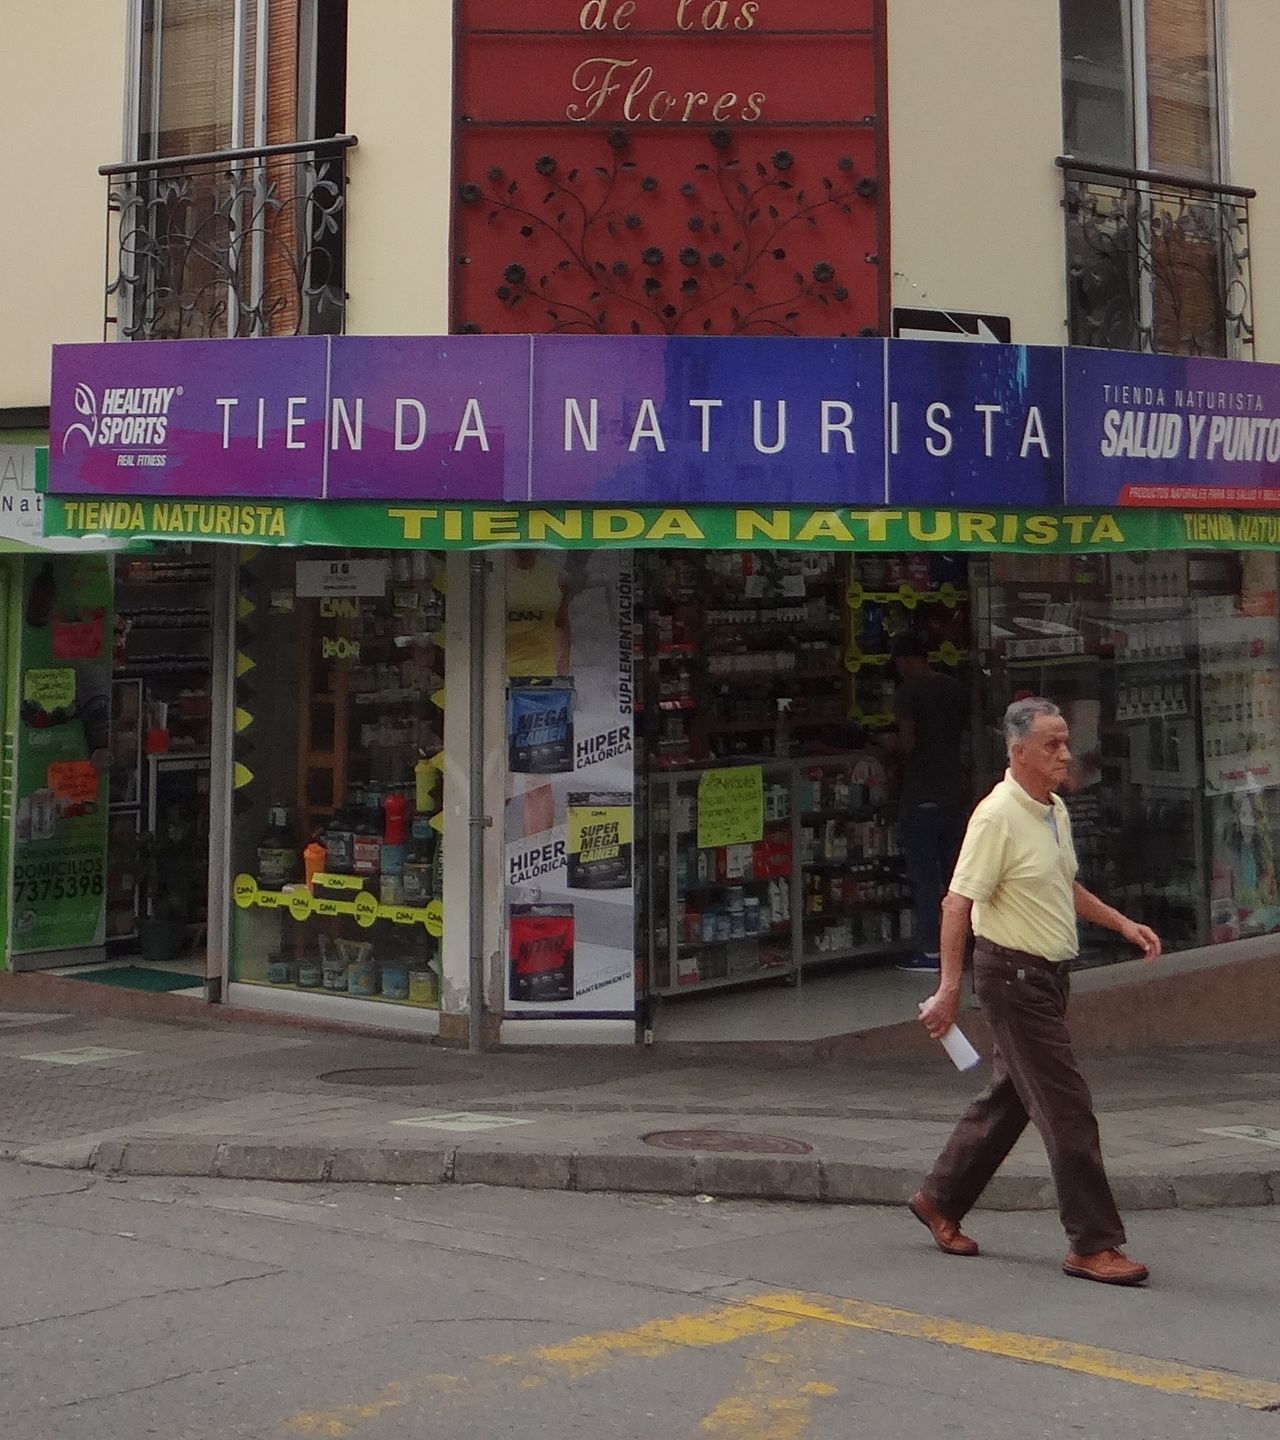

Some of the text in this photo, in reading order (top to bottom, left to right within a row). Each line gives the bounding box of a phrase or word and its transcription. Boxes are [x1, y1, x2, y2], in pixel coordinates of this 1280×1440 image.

[566, 57, 766, 123] Flores
[101, 386, 174, 415] HEALTHY
[1103, 384, 1264, 411] TIENDA NATURISTA
[98, 417, 168, 445] SPORTS
[215, 396, 1050, 458] TIENDA NATURISTA
[1101, 409, 1183, 459] SALUD
[1188, 414, 1207, 460] Y
[64, 502, 285, 537] TIENDA NATURISTA
[387, 507, 1125, 545] TIENDA NATURISTA
[1183, 513, 1234, 541] TIENDA
[616, 571, 633, 715] SUPLEMENTACIÓN
[576, 725, 631, 758] HIPER
[576, 742, 632, 769] CALÓRICA
[580, 821, 620, 839] SUPER
[580, 832, 620, 850] MEGA
[14, 858, 104, 881] DOMICILIOS
[510, 840, 566, 874] HIPER
[510, 856, 568, 885] CALÓRICA
[14, 874, 105, 903] 7375398
